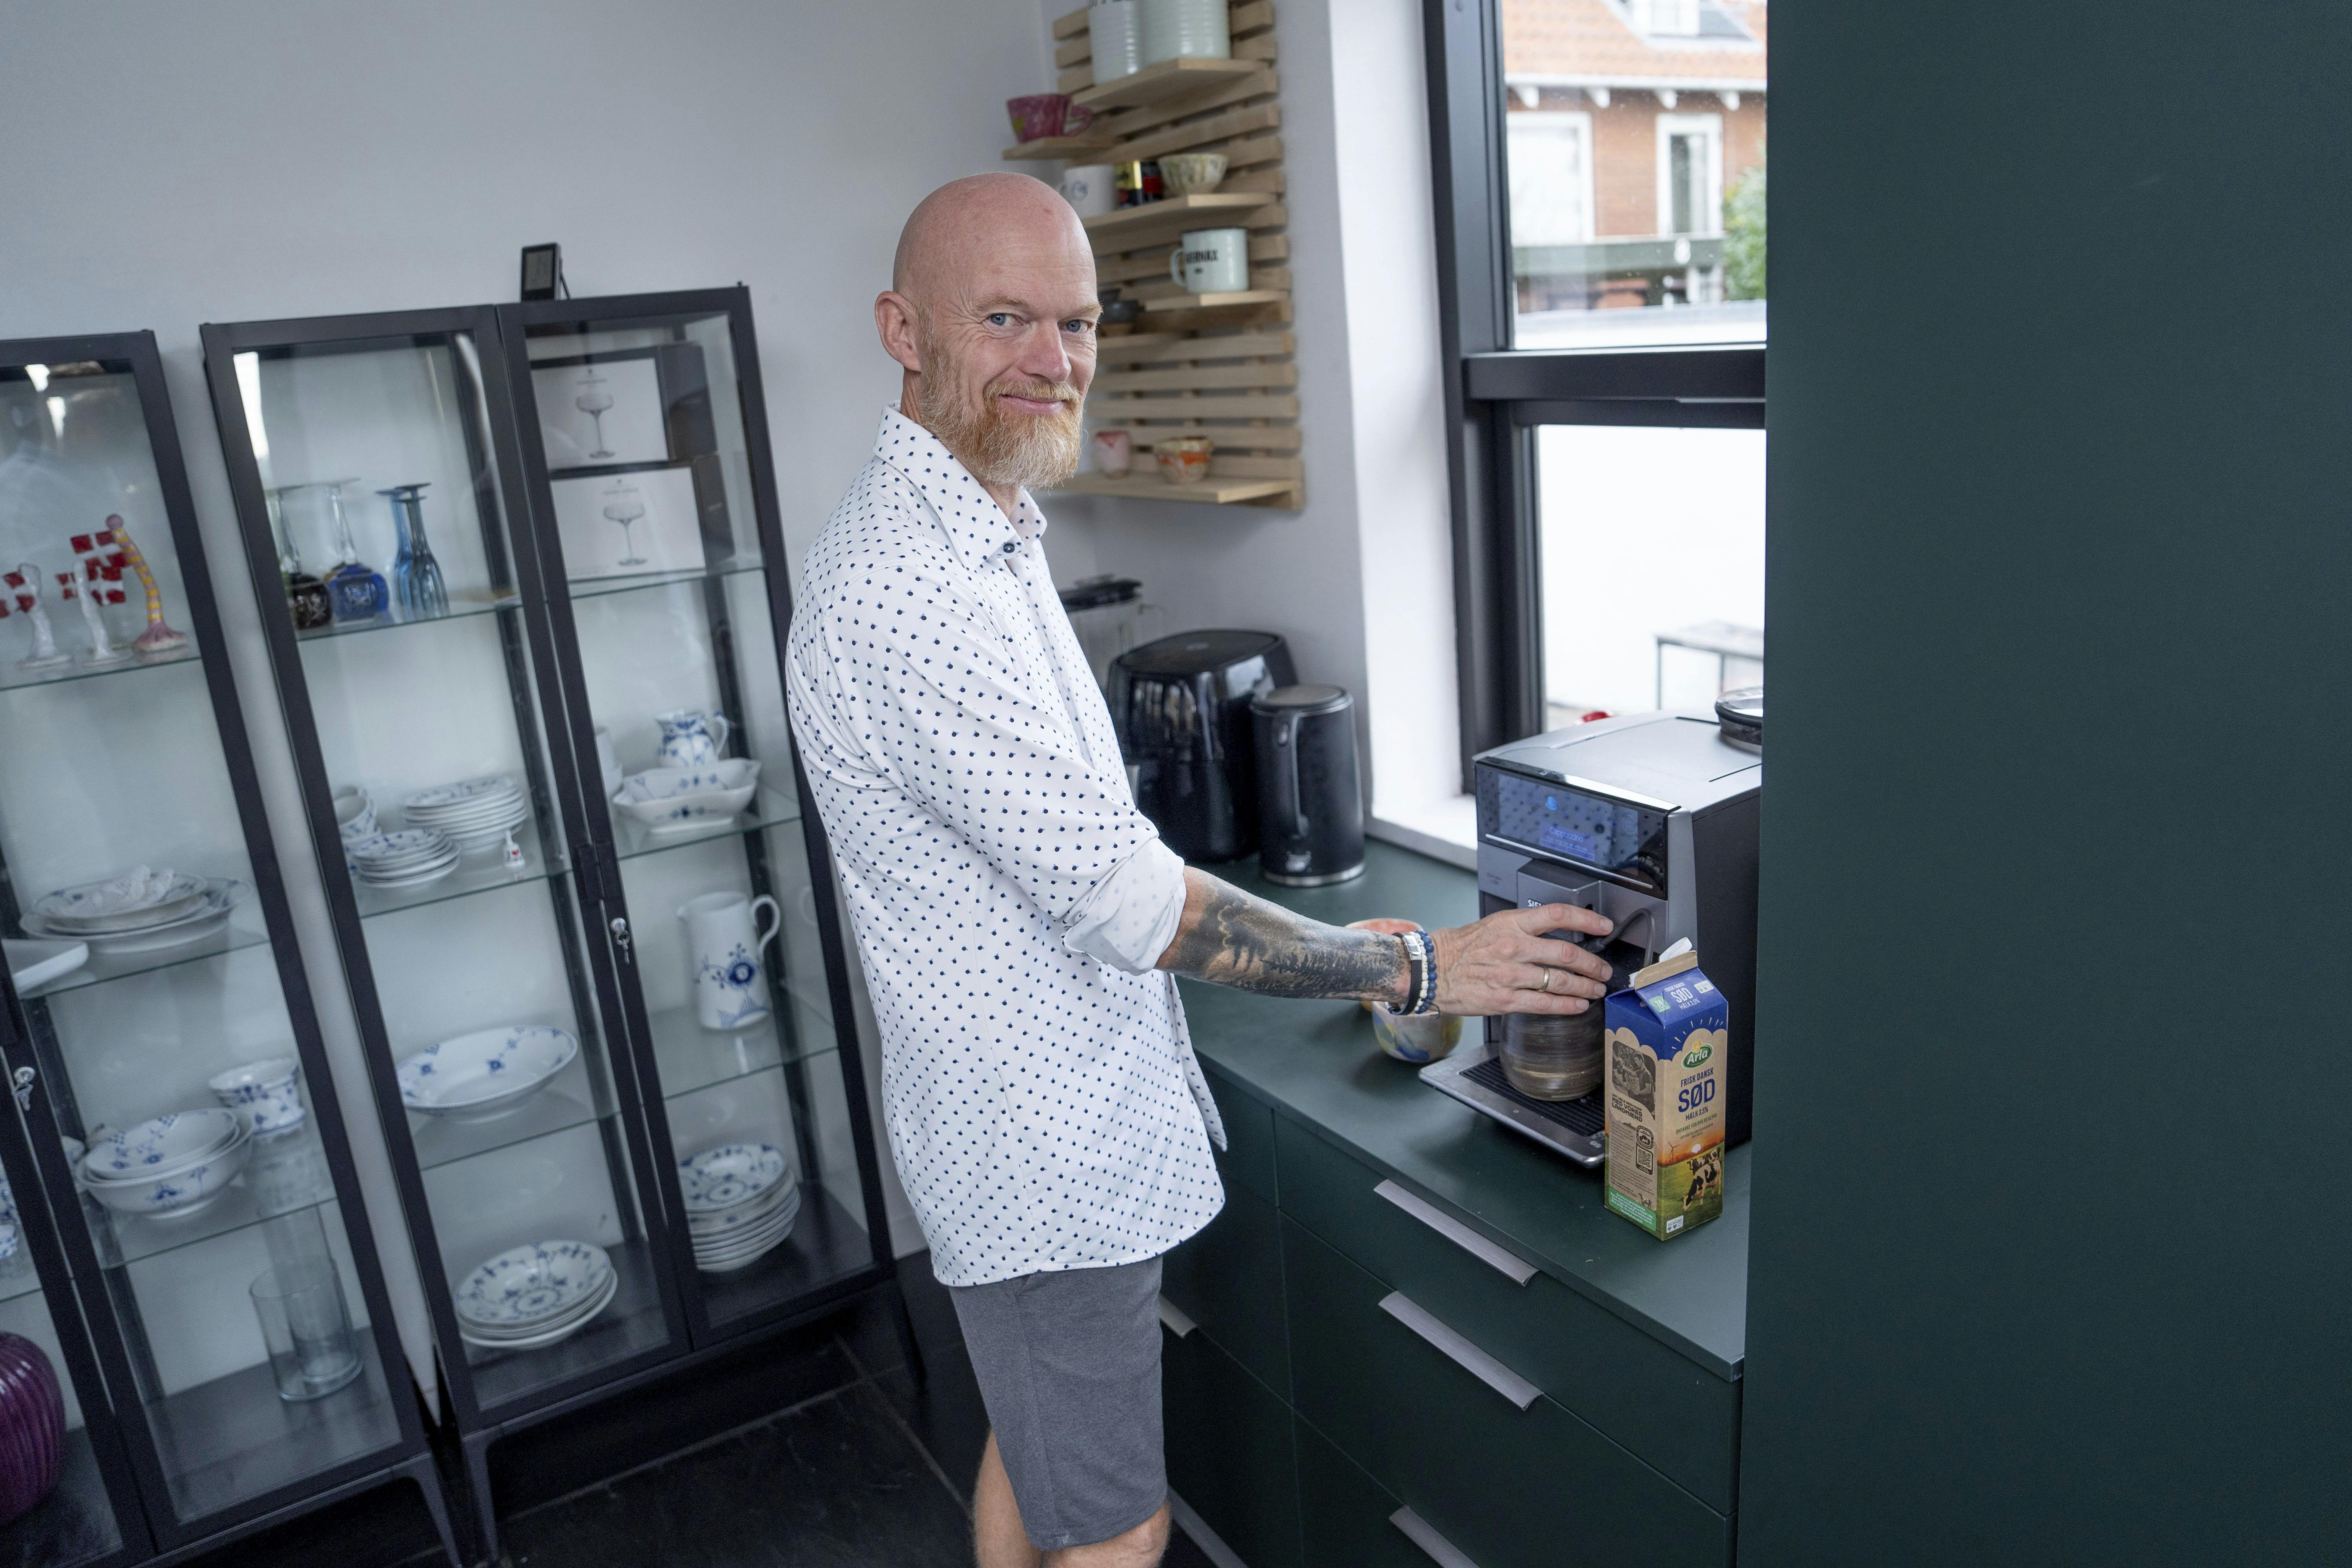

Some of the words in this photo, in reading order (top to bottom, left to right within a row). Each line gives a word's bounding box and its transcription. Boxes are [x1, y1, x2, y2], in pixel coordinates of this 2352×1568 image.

[1550, 827, 1583, 842] Cappuccino
[1671, 987, 1693, 1003] SØD
[1679, 1000, 1691, 1010] MÆLK
[1687, 1049, 1708, 1065] Arla
[1681, 1075, 1696, 1087] FRISK
[1697, 1067, 1713, 1081] DANSK
[1678, 1078, 1715, 1112] SØD
[1612, 1096, 1623, 1107] MED
[1624, 1103, 1642, 1117] VORES
[1612, 1102, 1642, 1122] LANDMÆND
[1686, 1111, 1698, 1121] MÆLK
[1699, 1106, 1708, 1115] 3,5%
